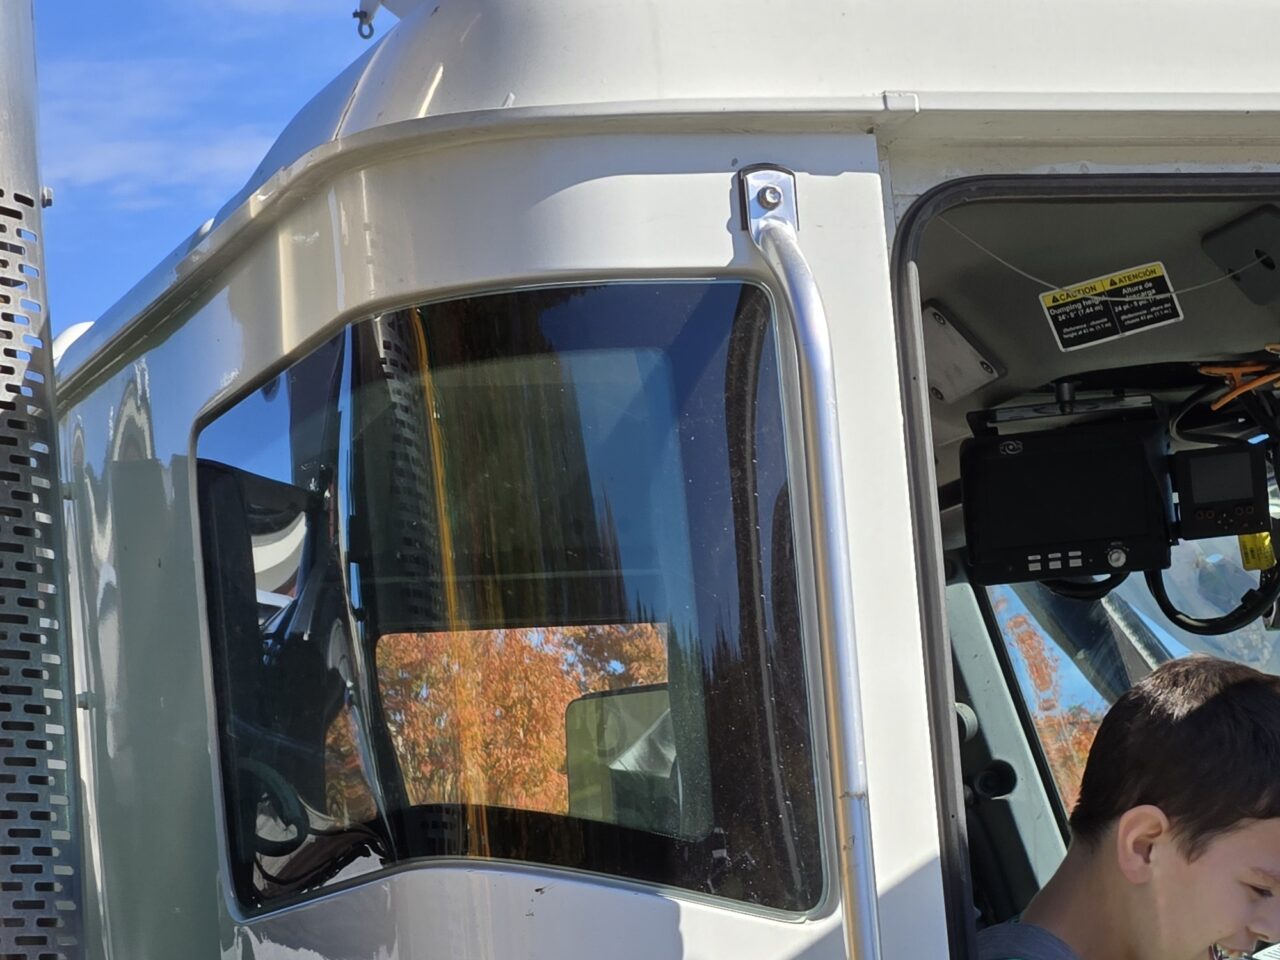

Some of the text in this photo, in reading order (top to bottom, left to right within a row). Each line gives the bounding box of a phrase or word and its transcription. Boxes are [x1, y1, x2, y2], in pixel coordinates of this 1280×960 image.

[1118, 268, 1157, 284] ATENCIÓN
[1059, 285, 1097, 301] CAUTION
[1050, 302, 1082, 315] Dumping
